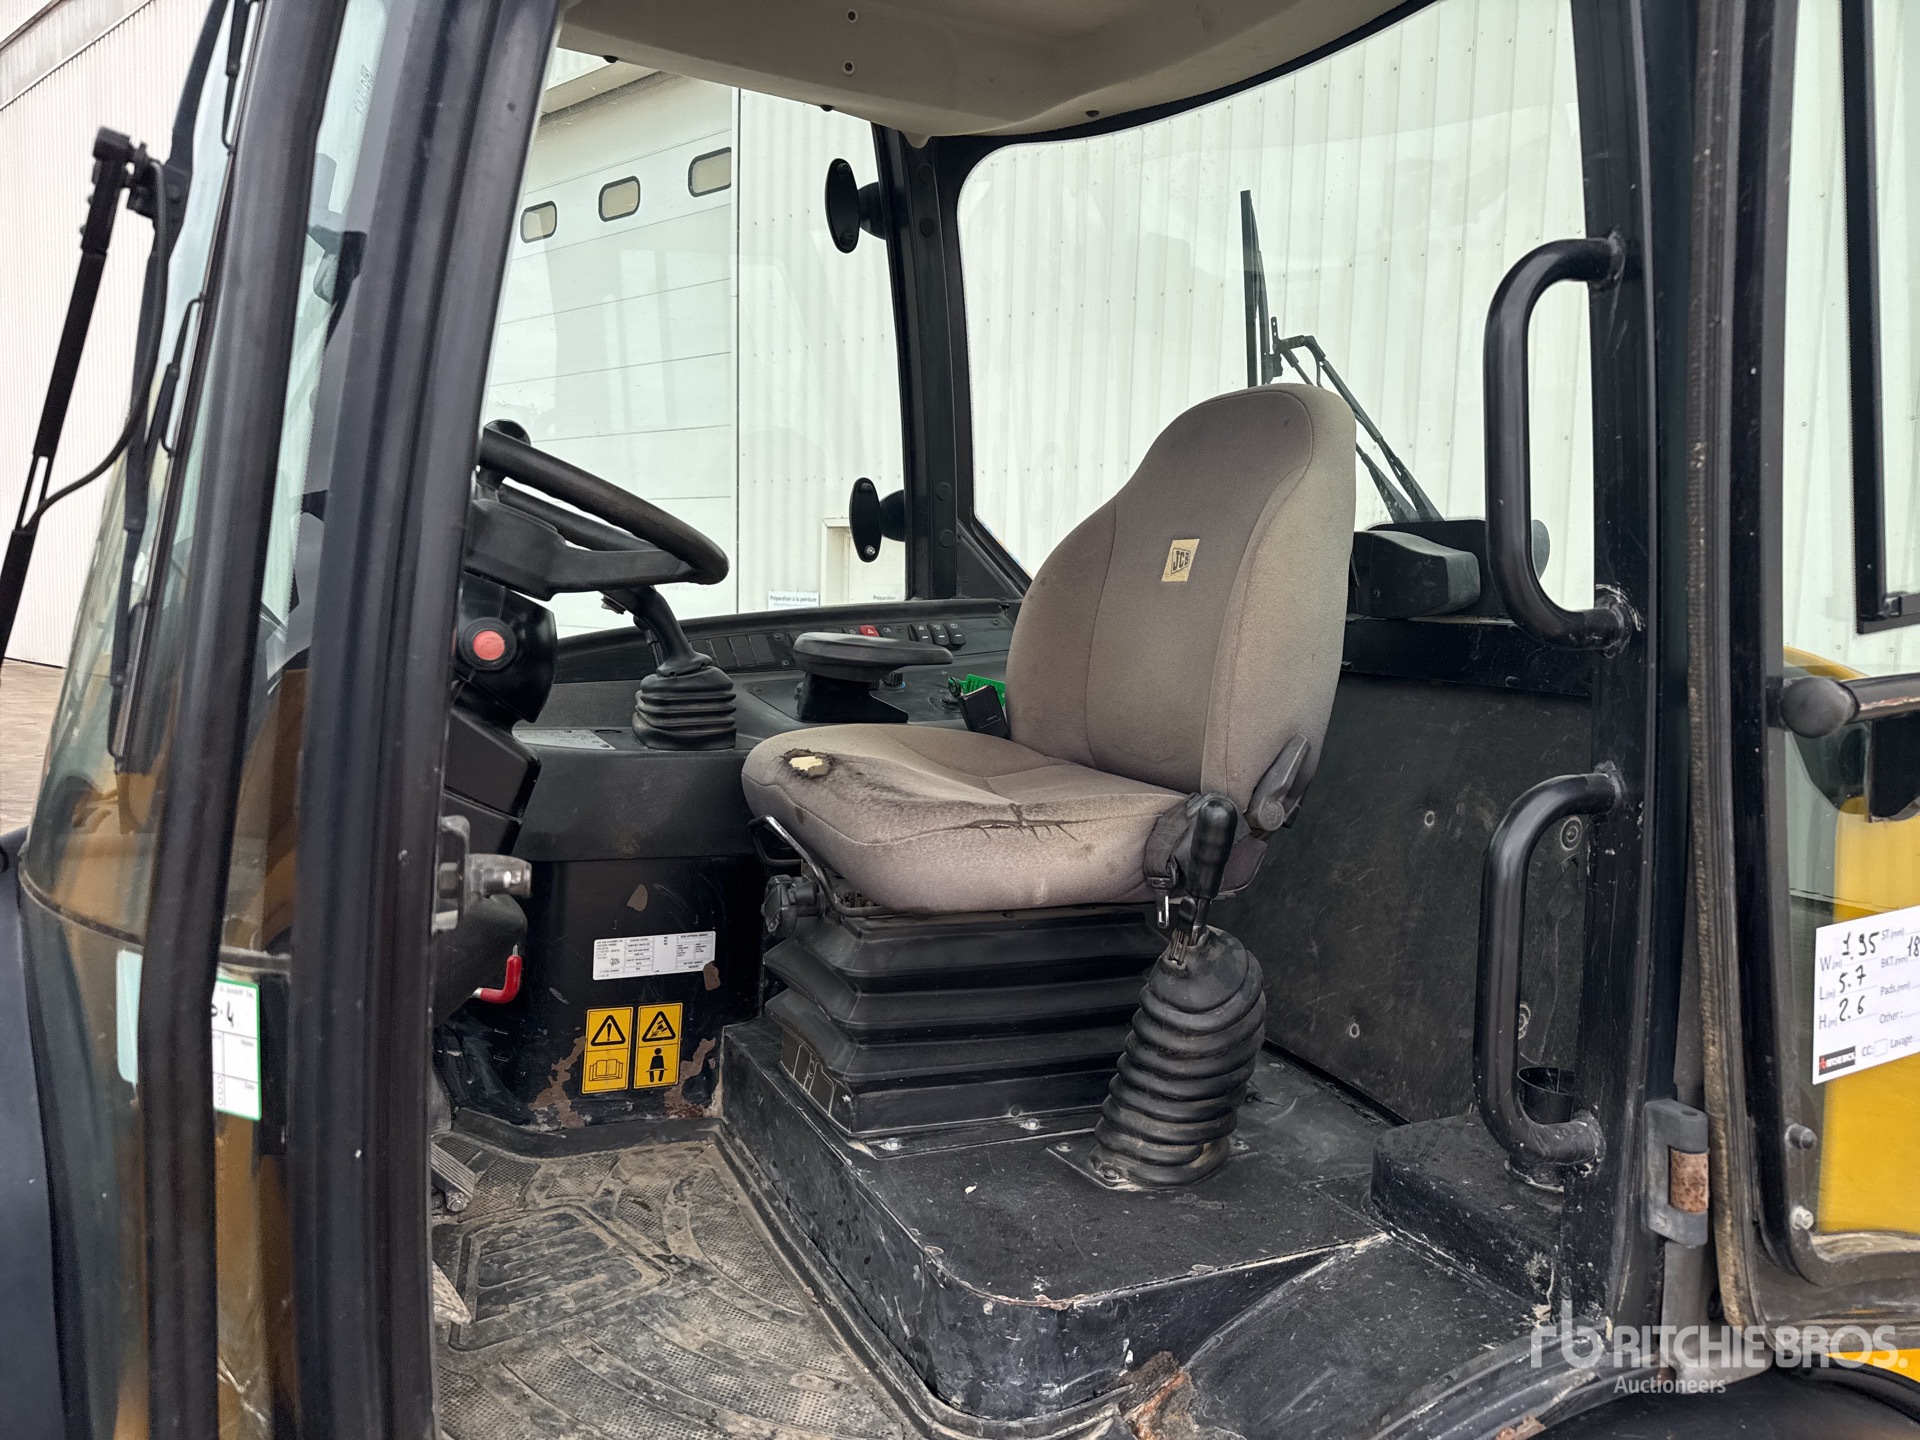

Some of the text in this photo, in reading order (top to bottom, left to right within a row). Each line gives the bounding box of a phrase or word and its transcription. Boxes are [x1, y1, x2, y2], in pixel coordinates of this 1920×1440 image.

[1172, 549, 1191, 572] JCB
[1841, 931, 1880, 960] 1.95
[1838, 995, 1866, 1022] 2.6
